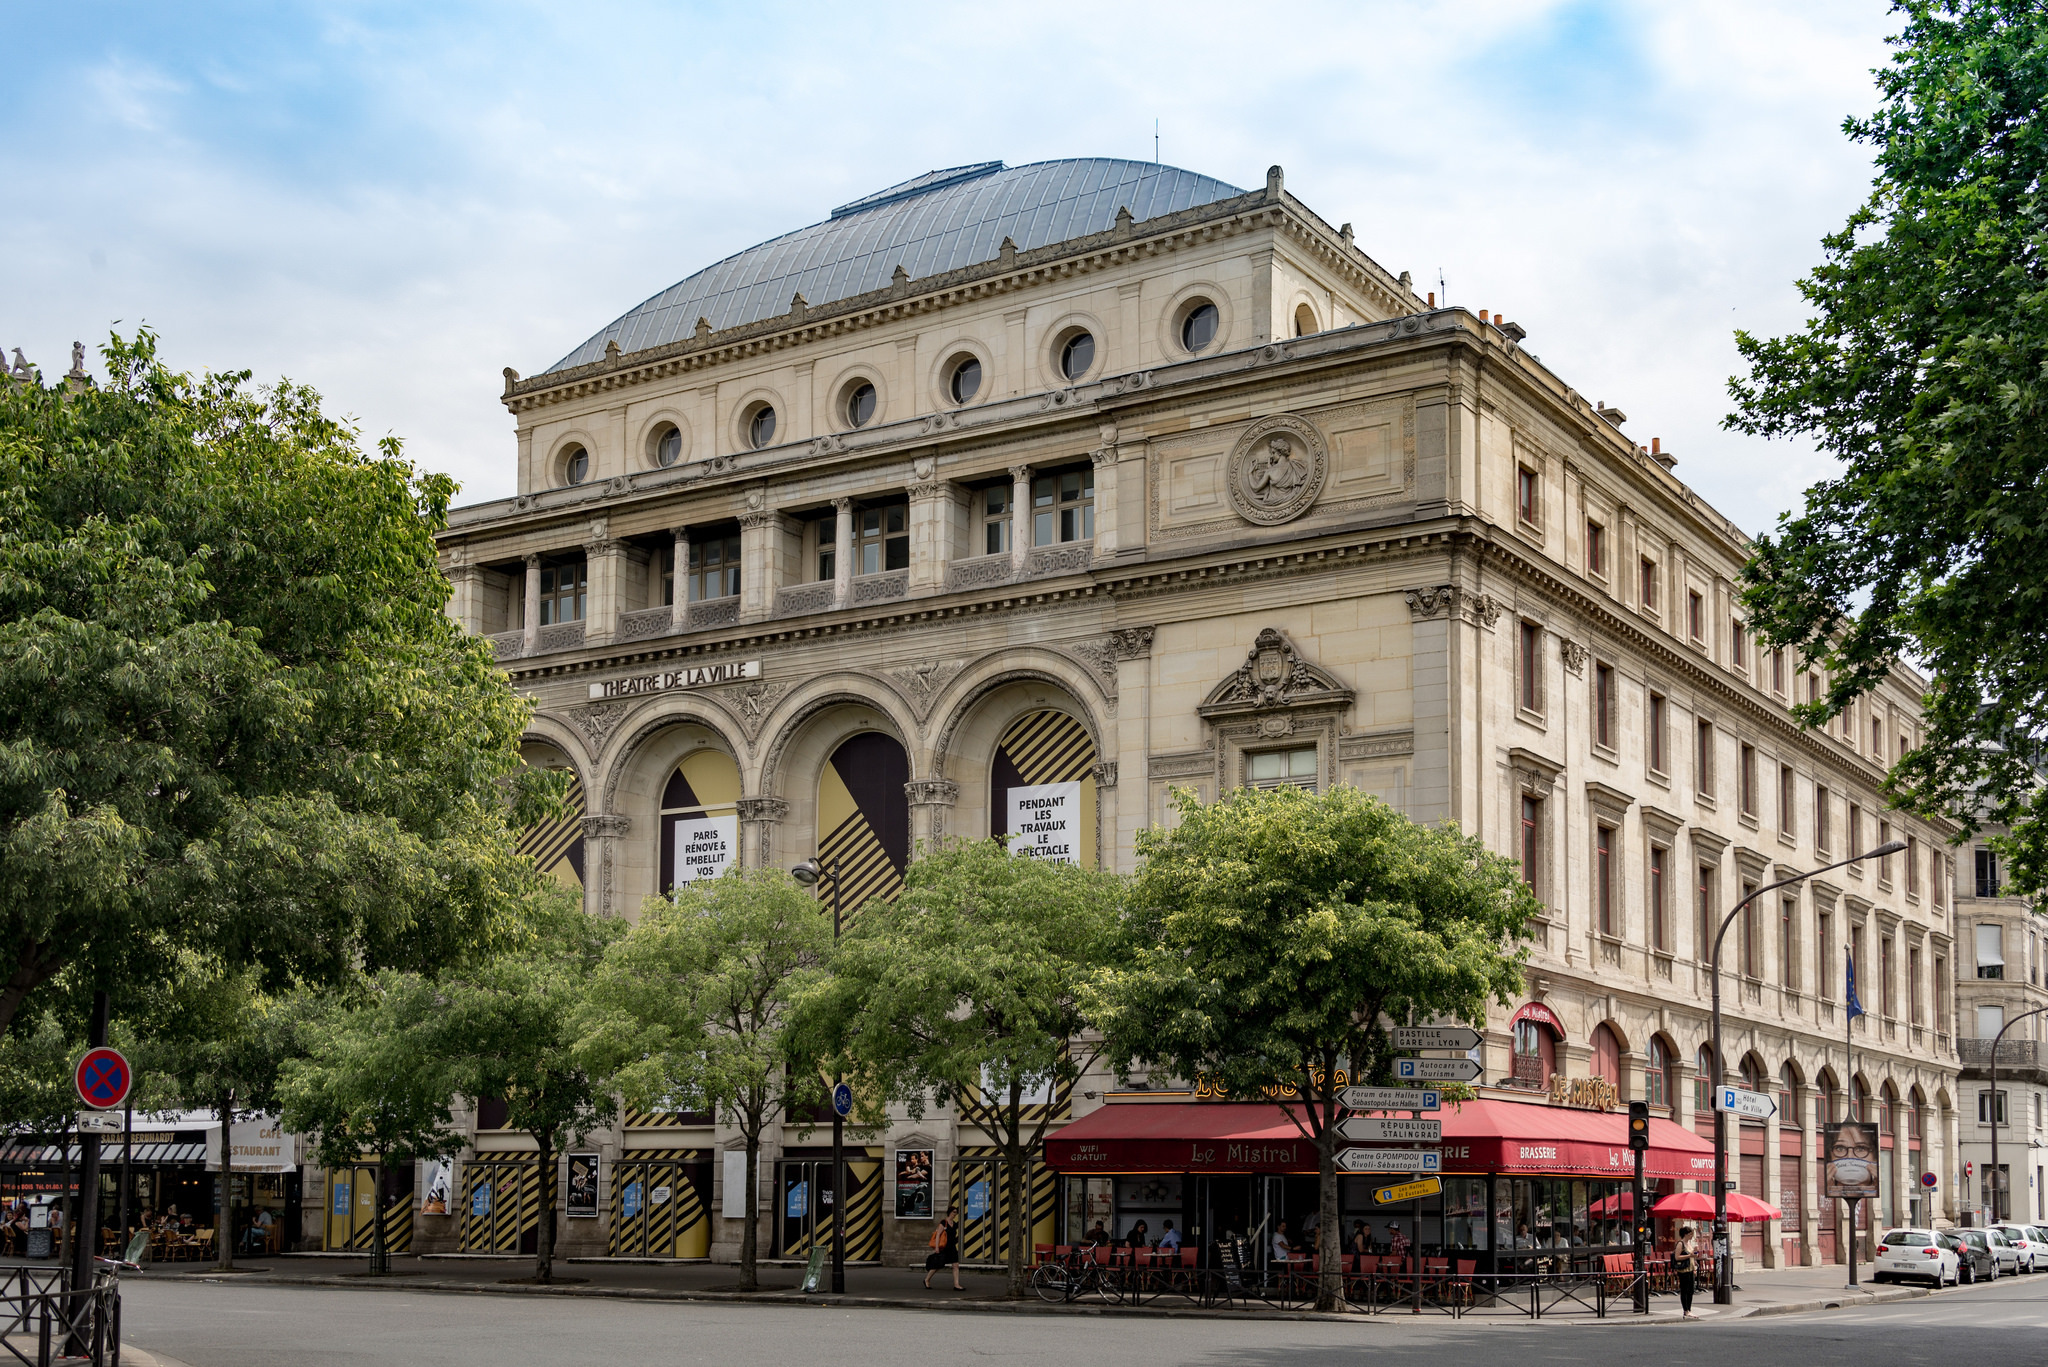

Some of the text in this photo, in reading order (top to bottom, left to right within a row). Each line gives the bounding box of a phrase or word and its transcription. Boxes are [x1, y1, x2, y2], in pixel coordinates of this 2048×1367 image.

[601, 662, 747, 697] THEATRE DE LA VILLE
[1020, 796, 1065, 810] PENDANT
[1035, 810, 1052, 820] LES
[1021, 820, 1066, 834] TRAVAUX
[693, 830, 718, 841] PARIS
[1038, 834, 1048, 844] LE
[685, 841, 726, 853] RÉNOVE &
[1017, 844, 1069, 858] SPECTACLE
[686, 854, 725, 865] EMBELLIT
[697, 866, 714, 876] VOS
[1523, 1005, 1550, 1020] Le Mistral
[1402, 1063, 1412, 1075] P
[1352, 1090, 1375, 1098] Forum
[1425, 1095, 1434, 1106] P
[1570, 1075, 1620, 1112] MISTRAL
[1727, 1093, 1757, 1105] P Hôtel
[1751, 1105, 1762, 1114] Ville
[1381, 1121, 1438, 1130] RÉPUBLIQUE
[230, 1146, 281, 1156] ESTAURANT
[1080, 1144, 1099, 1153] WIFI
[1192, 1143, 1298, 1164] Le Mistral
[1520, 1147, 1556, 1159] BRASSERIE
[1070, 1153, 1108, 1161] GRATUIT
[1352, 1152, 1374, 1160] Centre
[1608, 1148, 1619, 1167] Le
[1352, 1161, 1419, 1169] Rivoli-Sébastopol
